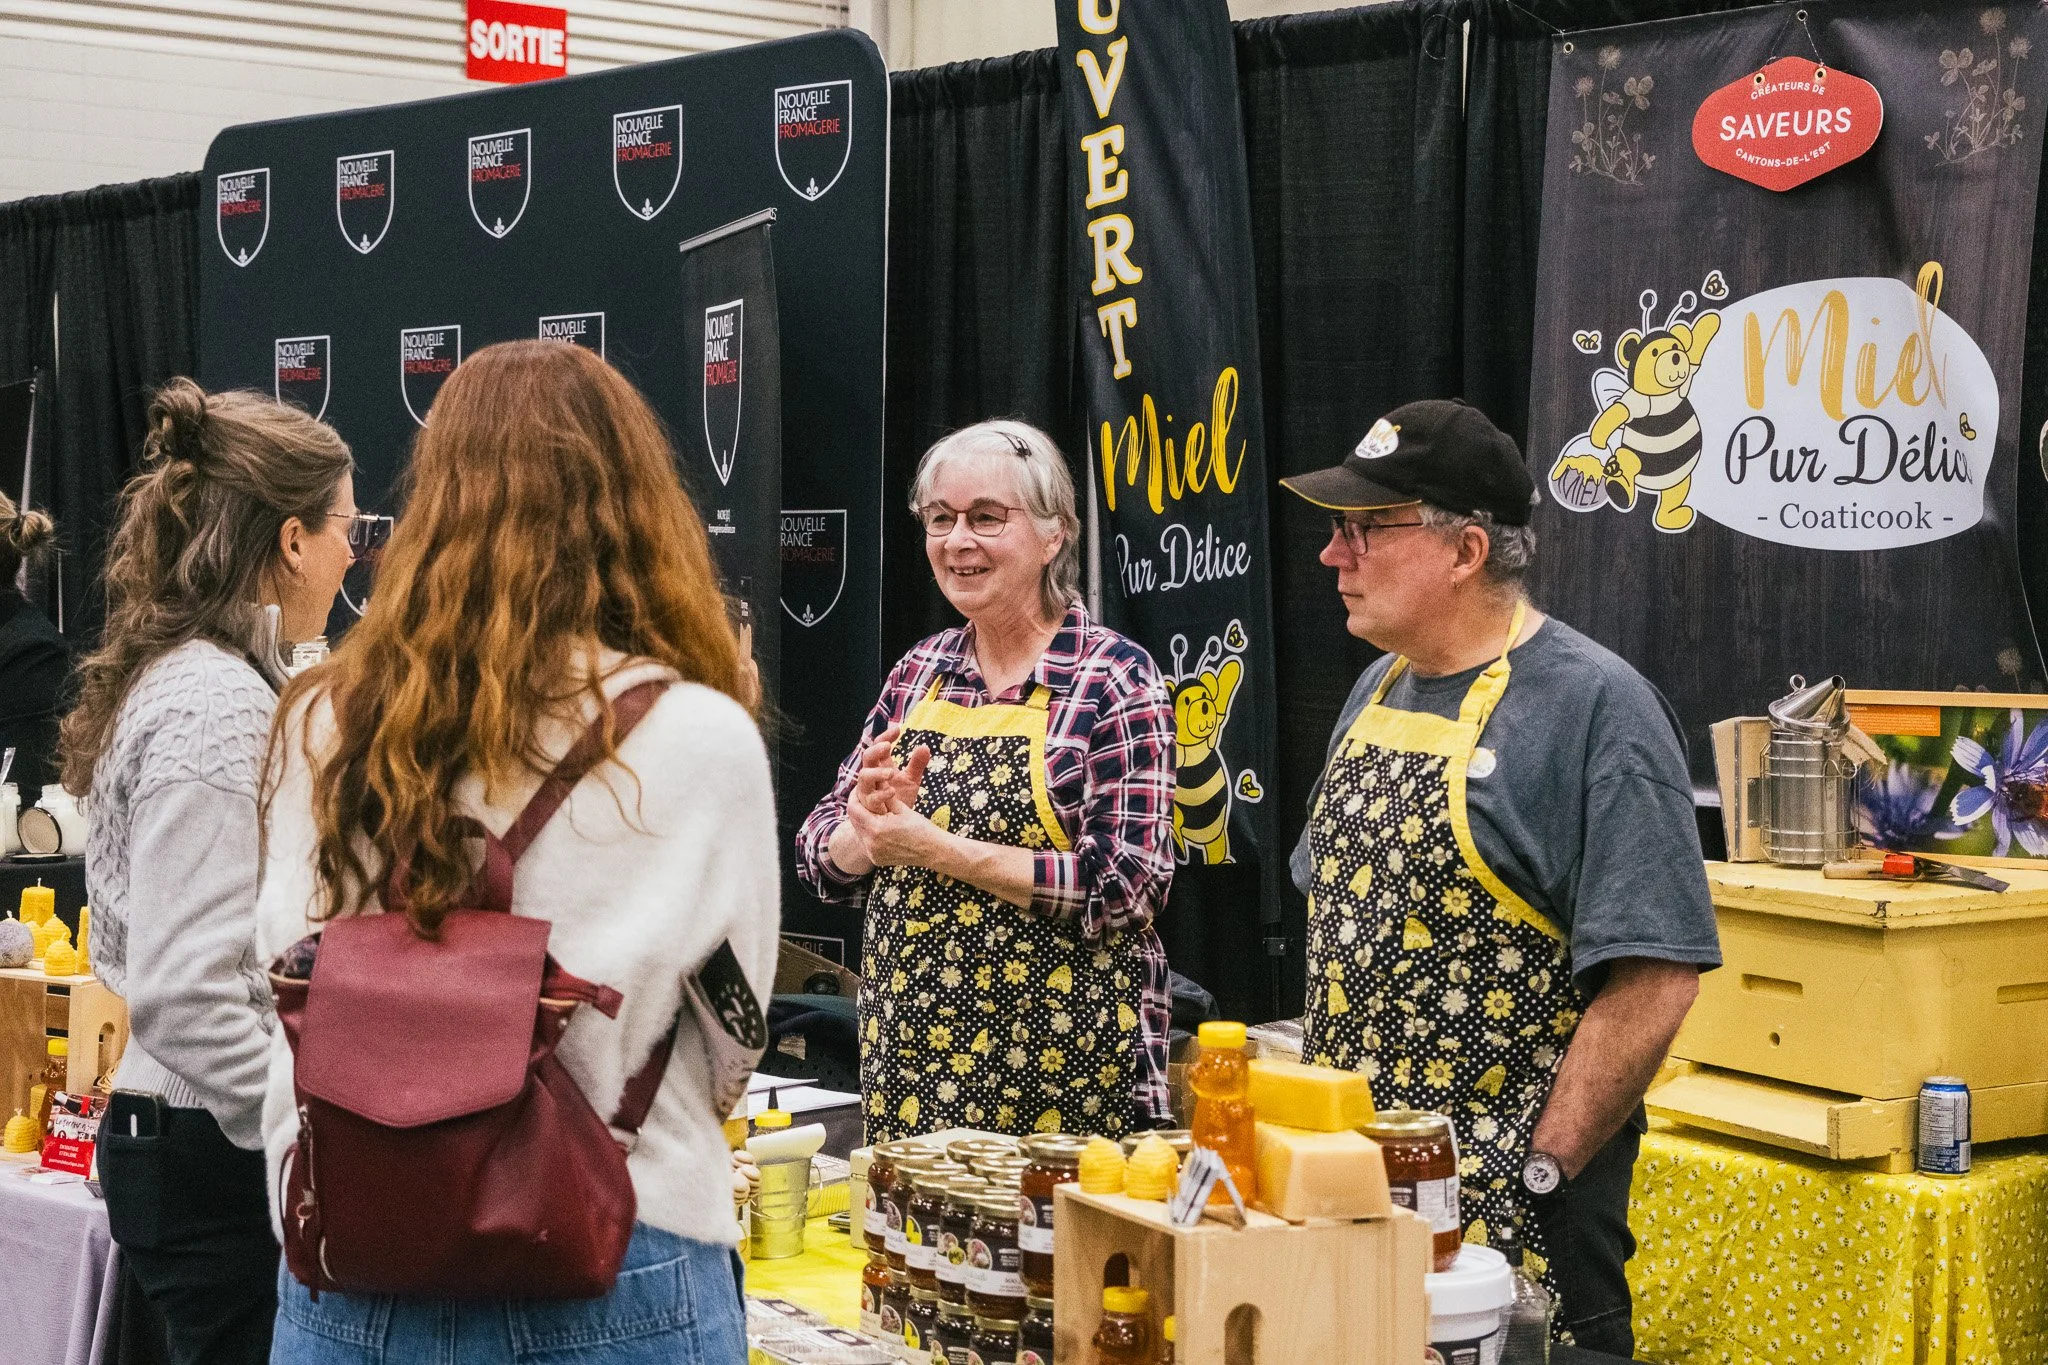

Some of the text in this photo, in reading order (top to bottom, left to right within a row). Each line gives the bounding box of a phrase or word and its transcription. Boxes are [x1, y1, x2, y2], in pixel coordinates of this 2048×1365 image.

[470, 18, 564, 67] SORTIE
[1751, 81, 1825, 100] CRÉATEURS DE
[779, 90, 831, 112] NOUVELLE
[617, 114, 664, 134] NOUVELLE
[779, 106, 817, 123] FRANCE
[1720, 106, 1852, 141] SAVEURS
[779, 118, 841, 137] FROMAGERIE
[472, 138, 514, 156] NOUVELLE
[617, 131, 652, 148] FRANCE
[472, 153, 503, 169] FRANCE
[617, 142, 672, 162] FROMAGERIE
[1735, 141, 1831, 168] CANTONS-DE-L'EST
[339, 158, 379, 174] NOUVELLE
[340, 173, 369, 188] FRANCE
[542, 320, 587, 337] NOUVELLE
[707, 312, 734, 339] NOUVELLE
[404, 333, 445, 348] NOUVELLE
[706, 338, 729, 363] FRANCE
[1743, 260, 1948, 422] Miel
[404, 347, 435, 362] FRANCE
[1100, 366, 1247, 515] Miel
[1725, 415, 1827, 485] Pur
[1779, 501, 1933, 530] Coaticook
[1115, 523, 1252, 599] Pur Délice
